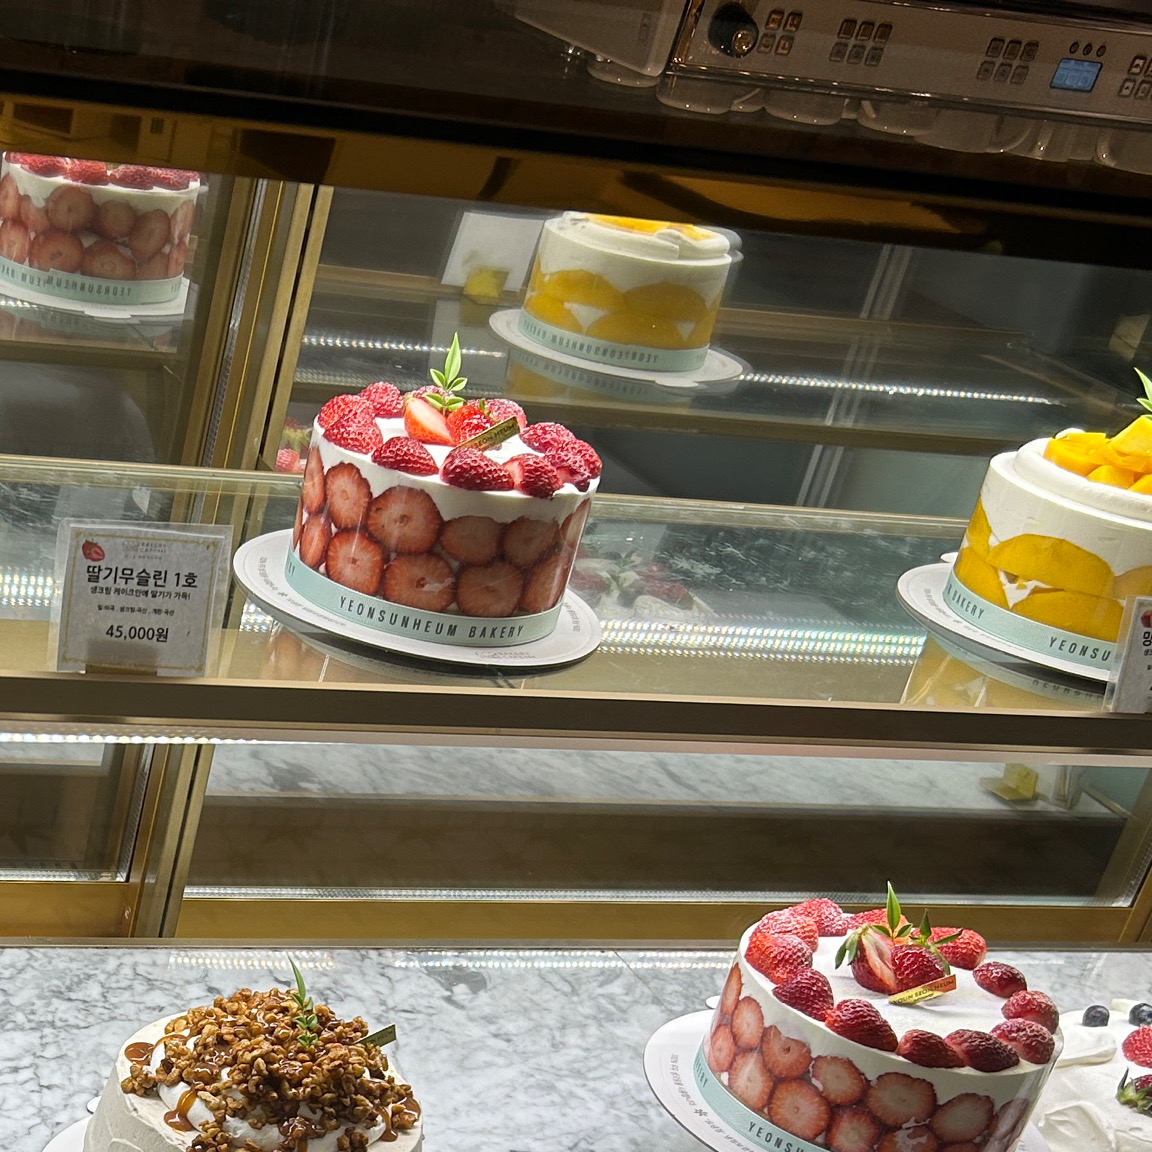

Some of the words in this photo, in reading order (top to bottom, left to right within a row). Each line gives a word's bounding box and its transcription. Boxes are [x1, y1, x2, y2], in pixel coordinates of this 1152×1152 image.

[86, 565, 168, 588] 딸기무슬린
[174, 571, 198, 589] 1호
[90, 586, 112, 596] 생크림
[150, 590, 172, 599] 딸기가
[952, 590, 985, 619] BAKERY
[339, 596, 458, 637] YEONSUNHEUM
[468, 624, 524, 639] BAKERY
[106, 624, 169, 643] 45,000원
